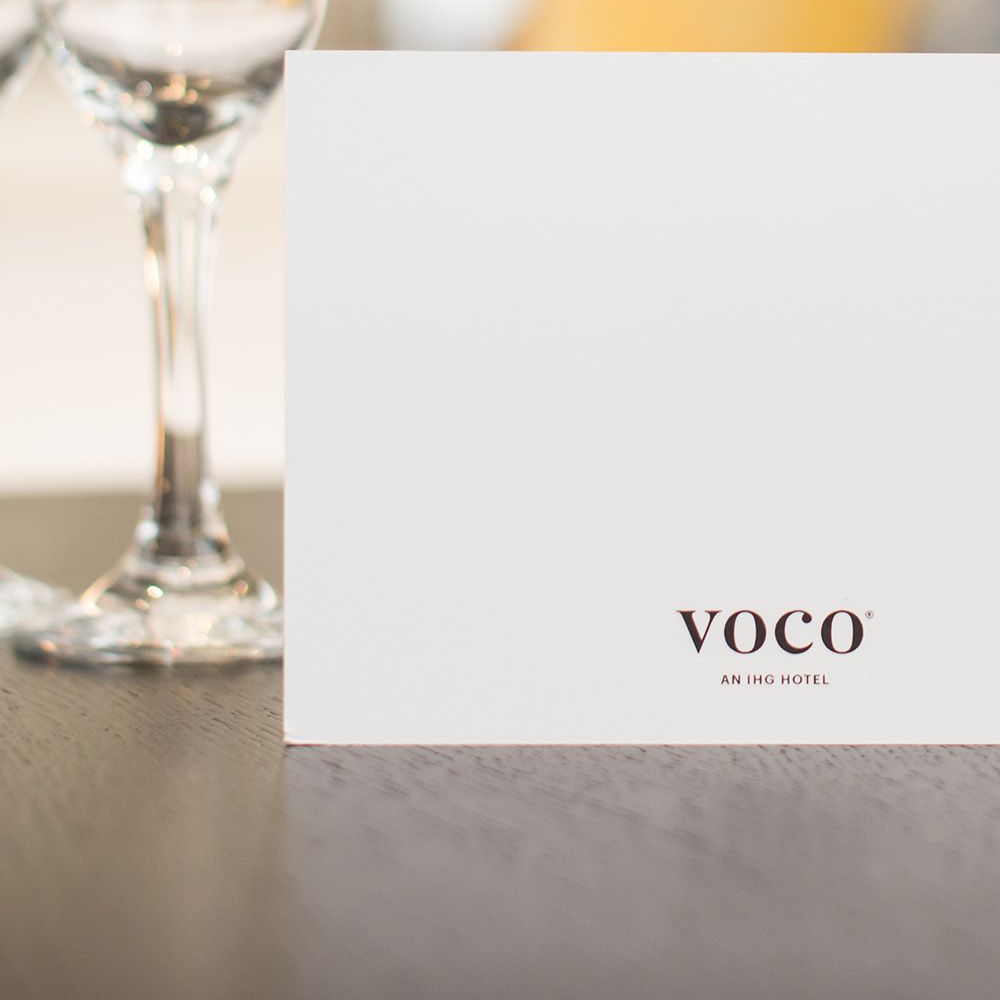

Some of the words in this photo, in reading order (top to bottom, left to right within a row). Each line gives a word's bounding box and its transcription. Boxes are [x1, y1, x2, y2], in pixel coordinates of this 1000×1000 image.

[720, 673, 741, 686] AN
[747, 673, 775, 686] IHG
[781, 673, 830, 686] HOTEL
